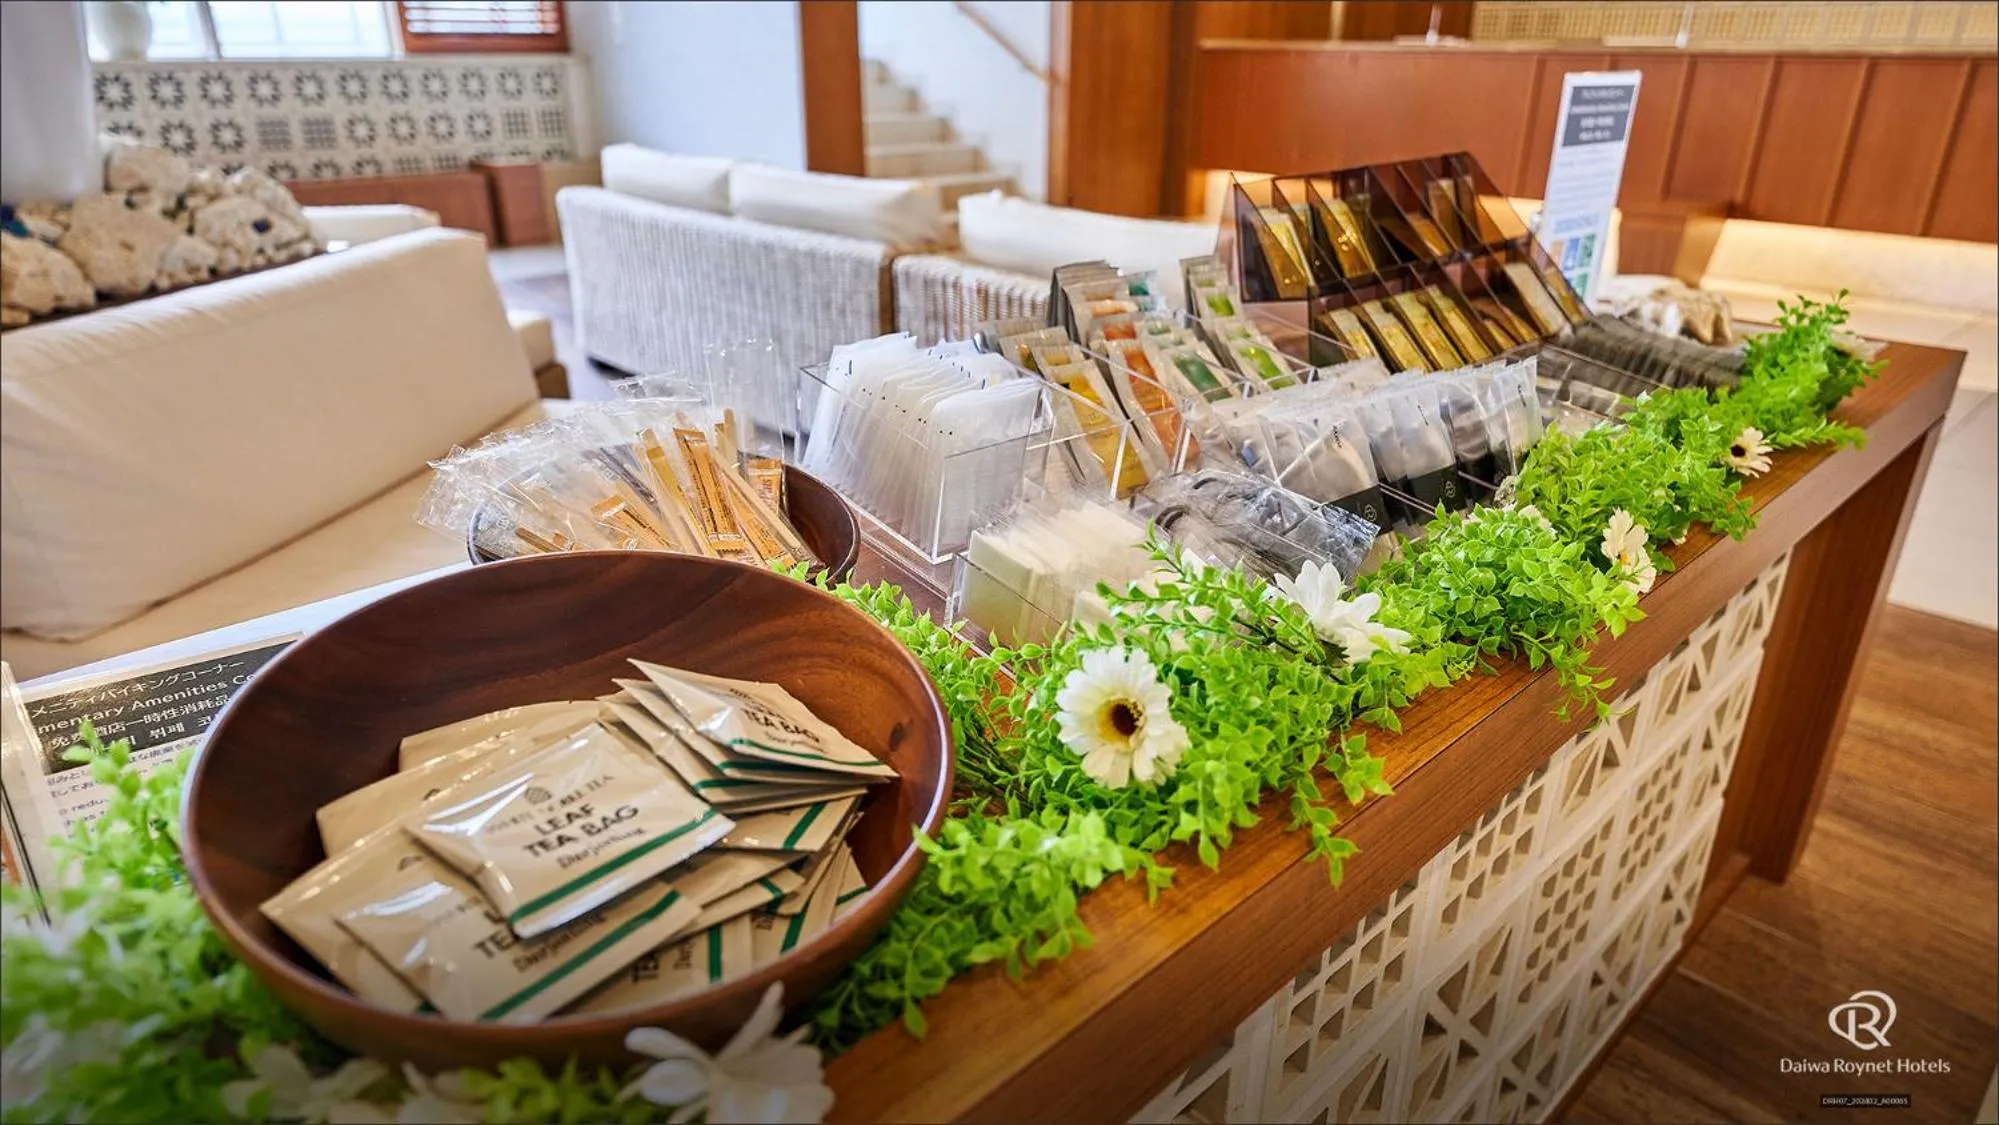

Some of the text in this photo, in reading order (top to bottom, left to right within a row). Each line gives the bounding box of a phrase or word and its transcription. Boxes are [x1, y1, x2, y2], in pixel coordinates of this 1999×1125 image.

[131, 681, 227, 711] Amenities
[522, 833, 579, 858] TEA
[580, 804, 639, 837] BAG
[534, 803, 594, 836] LEAF
